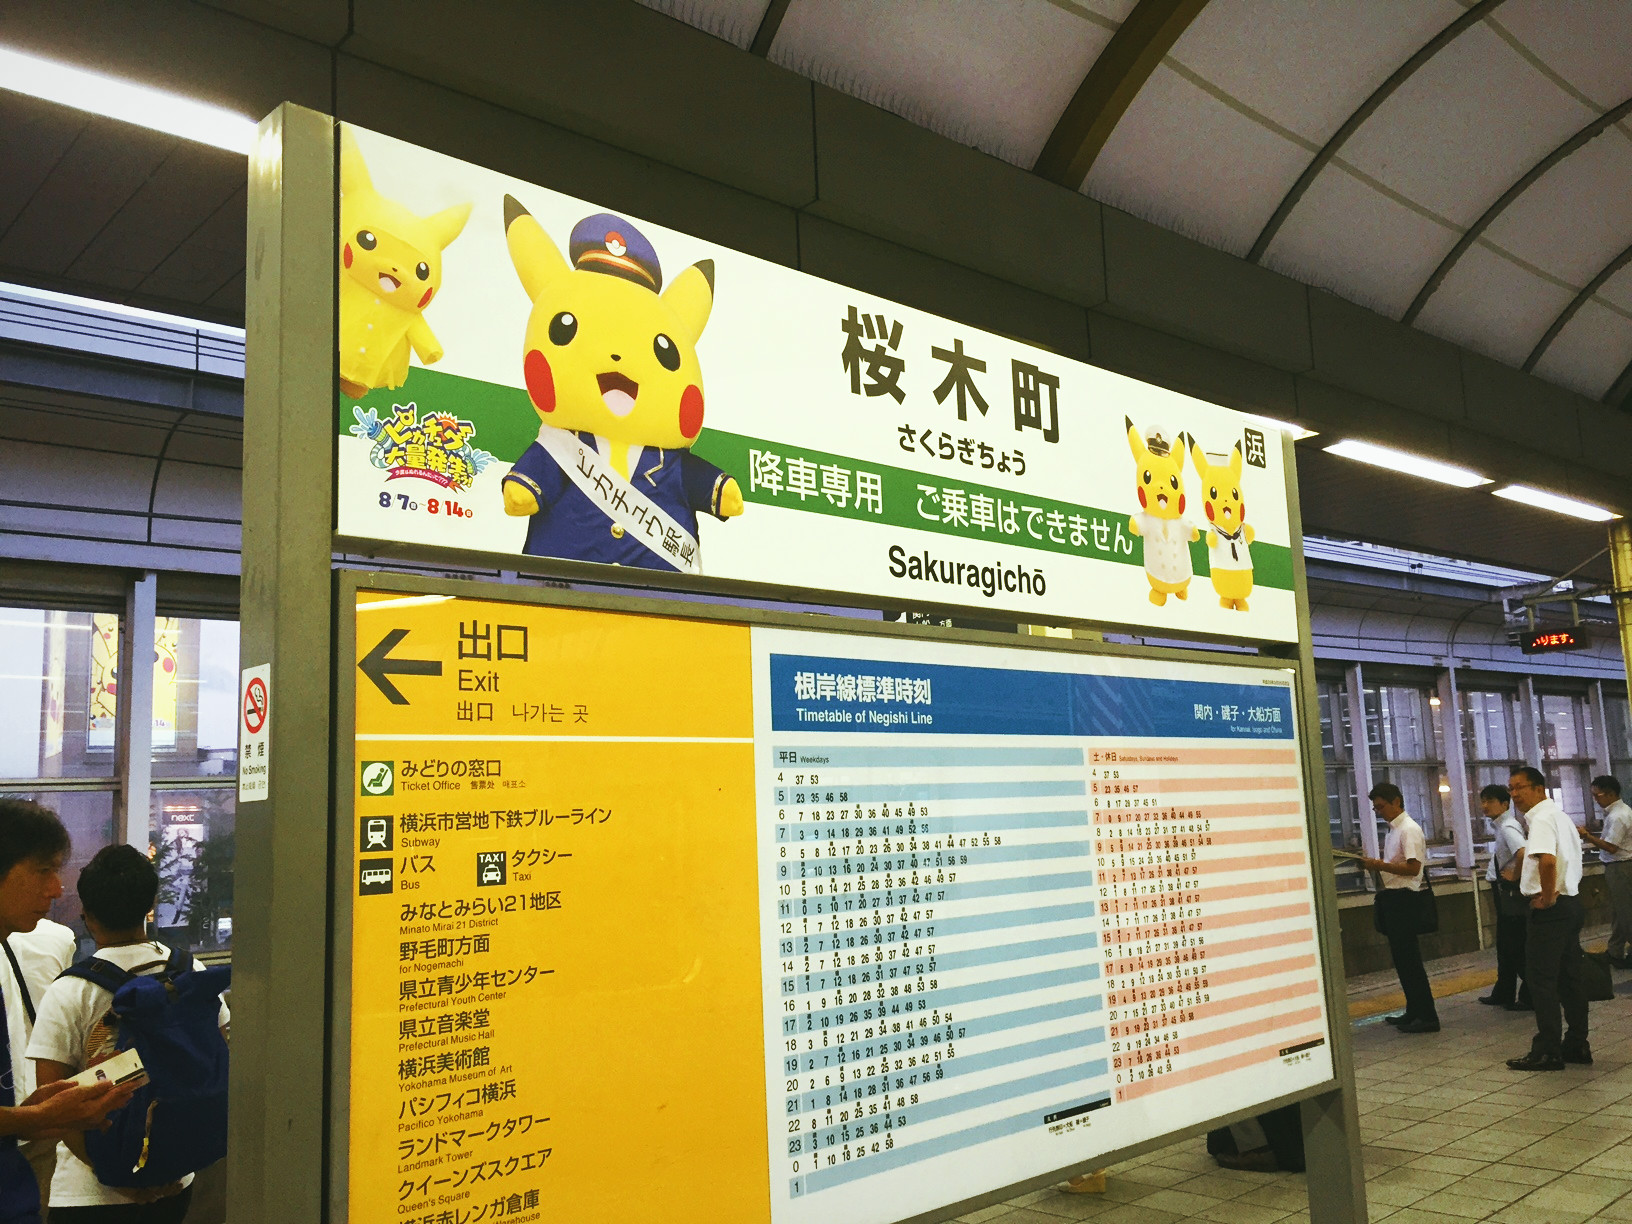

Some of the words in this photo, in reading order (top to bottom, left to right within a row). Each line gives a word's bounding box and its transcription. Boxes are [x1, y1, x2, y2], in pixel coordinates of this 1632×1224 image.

[841, 304, 1060, 443] 桜木町
[897, 424, 1027, 476] さくらぎちょう
[1246, 432, 1265, 467] 浜
[576, 447, 695, 568] ピカチュウ駅長
[748, 448, 883, 515] 降車専用
[916, 483, 1133, 556] ご乗車はできません
[888, 545, 1046, 597] Sakuragichō
[458, 619, 529, 662] 出口
[458, 669, 500, 693] Exit
[795, 672, 931, 705] 根岸線標準時刻
[457, 701, 494, 723] 出口
[512, 703, 565, 723] 나가는
[573, 703, 589, 725] 곳
[796, 707, 852, 723] Timetable
[855, 710, 866, 723] of
[869, 711, 909, 727] Negishi
[911, 712, 933, 725] Line
[1194, 703, 1281, 723] 関内・磯子・大船方面
[401, 759, 501, 778] みどりの窓口
[779, 751, 797, 764] 平日
[800, 755, 830, 764] Weekdays
[1093, 751, 1117, 762] 土・休日
[242, 766, 249, 775] No
[249, 764, 266, 776] Smoking
[778, 772, 784, 782] 4
[796, 774, 804, 786] 37
[810, 774, 818, 784] 53
[401, 779, 430, 792] Ticket
[433, 779, 461, 791] Office
[778, 790, 784, 802] 5
[796, 794, 806, 804] 23
[810, 792, 820, 802] 35
[826, 792, 834, 802] 46
[840, 792, 848, 802] 58
[400, 808, 612, 832] 横浜市営地下鉄ブルーライン
[778, 808, 784, 820] 6
[798, 812, 804, 822] 7
[812, 810, 820, 820] 18
[826, 810, 834, 820] 23
[840, 810, 848, 820] 27
[854, 808, 862, 820] 30
[868, 808, 876, 818] 36
[882, 806, 890, 818] 40
[894, 808, 902, 818] 45
[908, 806, 916, 816] 49
[920, 806, 928, 816] 53
[401, 836, 441, 849] Subway
[400, 853, 436, 874] バス
[479, 853, 504, 863] TAXI
[511, 848, 573, 868] タクシー
[400, 878, 420, 890] Bus
[513, 872, 532, 882] Taxi
[400, 891, 562, 922] みなとみらい21地区
[399, 924, 431, 936] Minato
[432, 921, 454, 933] Mirai
[456, 920, 467, 930] 21
[469, 917, 499, 929] District
[400, 934, 491, 962] 野毛町方面
[782, 942, 792, 954] 13
[804, 940, 808, 954] 2
[818, 940, 824, 952] 7
[832, 938, 840, 950] 12
[846, 936, 854, 948] 18
[860, 934, 868, 946] 26
[874, 934, 882, 944] 30
[888, 932, 896, 942] 37
[900, 928, 910, 940] 42
[914, 928, 922, 938] 47
[926, 926, 934, 936] 57
[399, 964, 412, 975] for
[413, 958, 464, 974] Nogemachi
[399, 966, 555, 1001] 県立青少年センター
[399, 998, 449, 1014] Prefectural
[451, 994, 476, 1005] Youth
[478, 990, 507, 1002] Center
[399, 1008, 491, 1041] 県立音楽堂
[398, 1037, 449, 1053] Prefectural
[450, 1032, 476, 1044] Music
[477, 1029, 495, 1041] Hall
[398, 1046, 491, 1081] 横浜美術館
[398, 1078, 447, 1093] Yokohama
[449, 1070, 486, 1084] Museum
[488, 1067, 497, 1076] of
[500, 1064, 513, 1074] Art
[399, 1079, 517, 1120] パシフィコ横浜
[398, 1117, 435, 1133] Pacifico
[437, 1108, 484, 1125] Yokohama
[788, 1120, 800, 1132] 22
[812, 1118, 816, 1130] 8
[826, 1114, 832, 1126] 11
[840, 1110, 848, 1122] 20
[854, 1106, 864, 1118] 25
[868, 1104, 878, 1114] 35
[882, 1098, 890, 1110] 41
[896, 1096, 906, 1108] 48
[910, 1094, 918, 1104] 58
[398, 1115, 551, 1160] ランドマークタワー
[790, 1140, 802, 1154] 23
[812, 1138, 818, 1150] 3
[826, 1134, 836, 1146] 10
[840, 1130, 850, 1142] 15
[856, 1126, 864, 1138] 25
[870, 1122, 878, 1134] 36
[884, 1118, 892, 1130] 44
[898, 1116, 906, 1128] 53
[398, 1155, 444, 1174] Landmark
[446, 1149, 474, 1163] Tower
[792, 1160, 800, 1172] 0
[814, 1158, 818, 1170] 1
[828, 1154, 836, 1166] 10
[842, 1150, 850, 1162] 18
[856, 1146, 866, 1158] 25
[872, 1142, 880, 1154] 42
[886, 1138, 894, 1150] 58
[399, 1148, 553, 1201] クイーンズスクエア
[794, 1182, 798, 1192] 1
[397, 1198, 436, 1215] Queen's
[438, 1190, 471, 1206] Square
[400, 1189, 540, 1224] 浜赤レンガ倉庫
